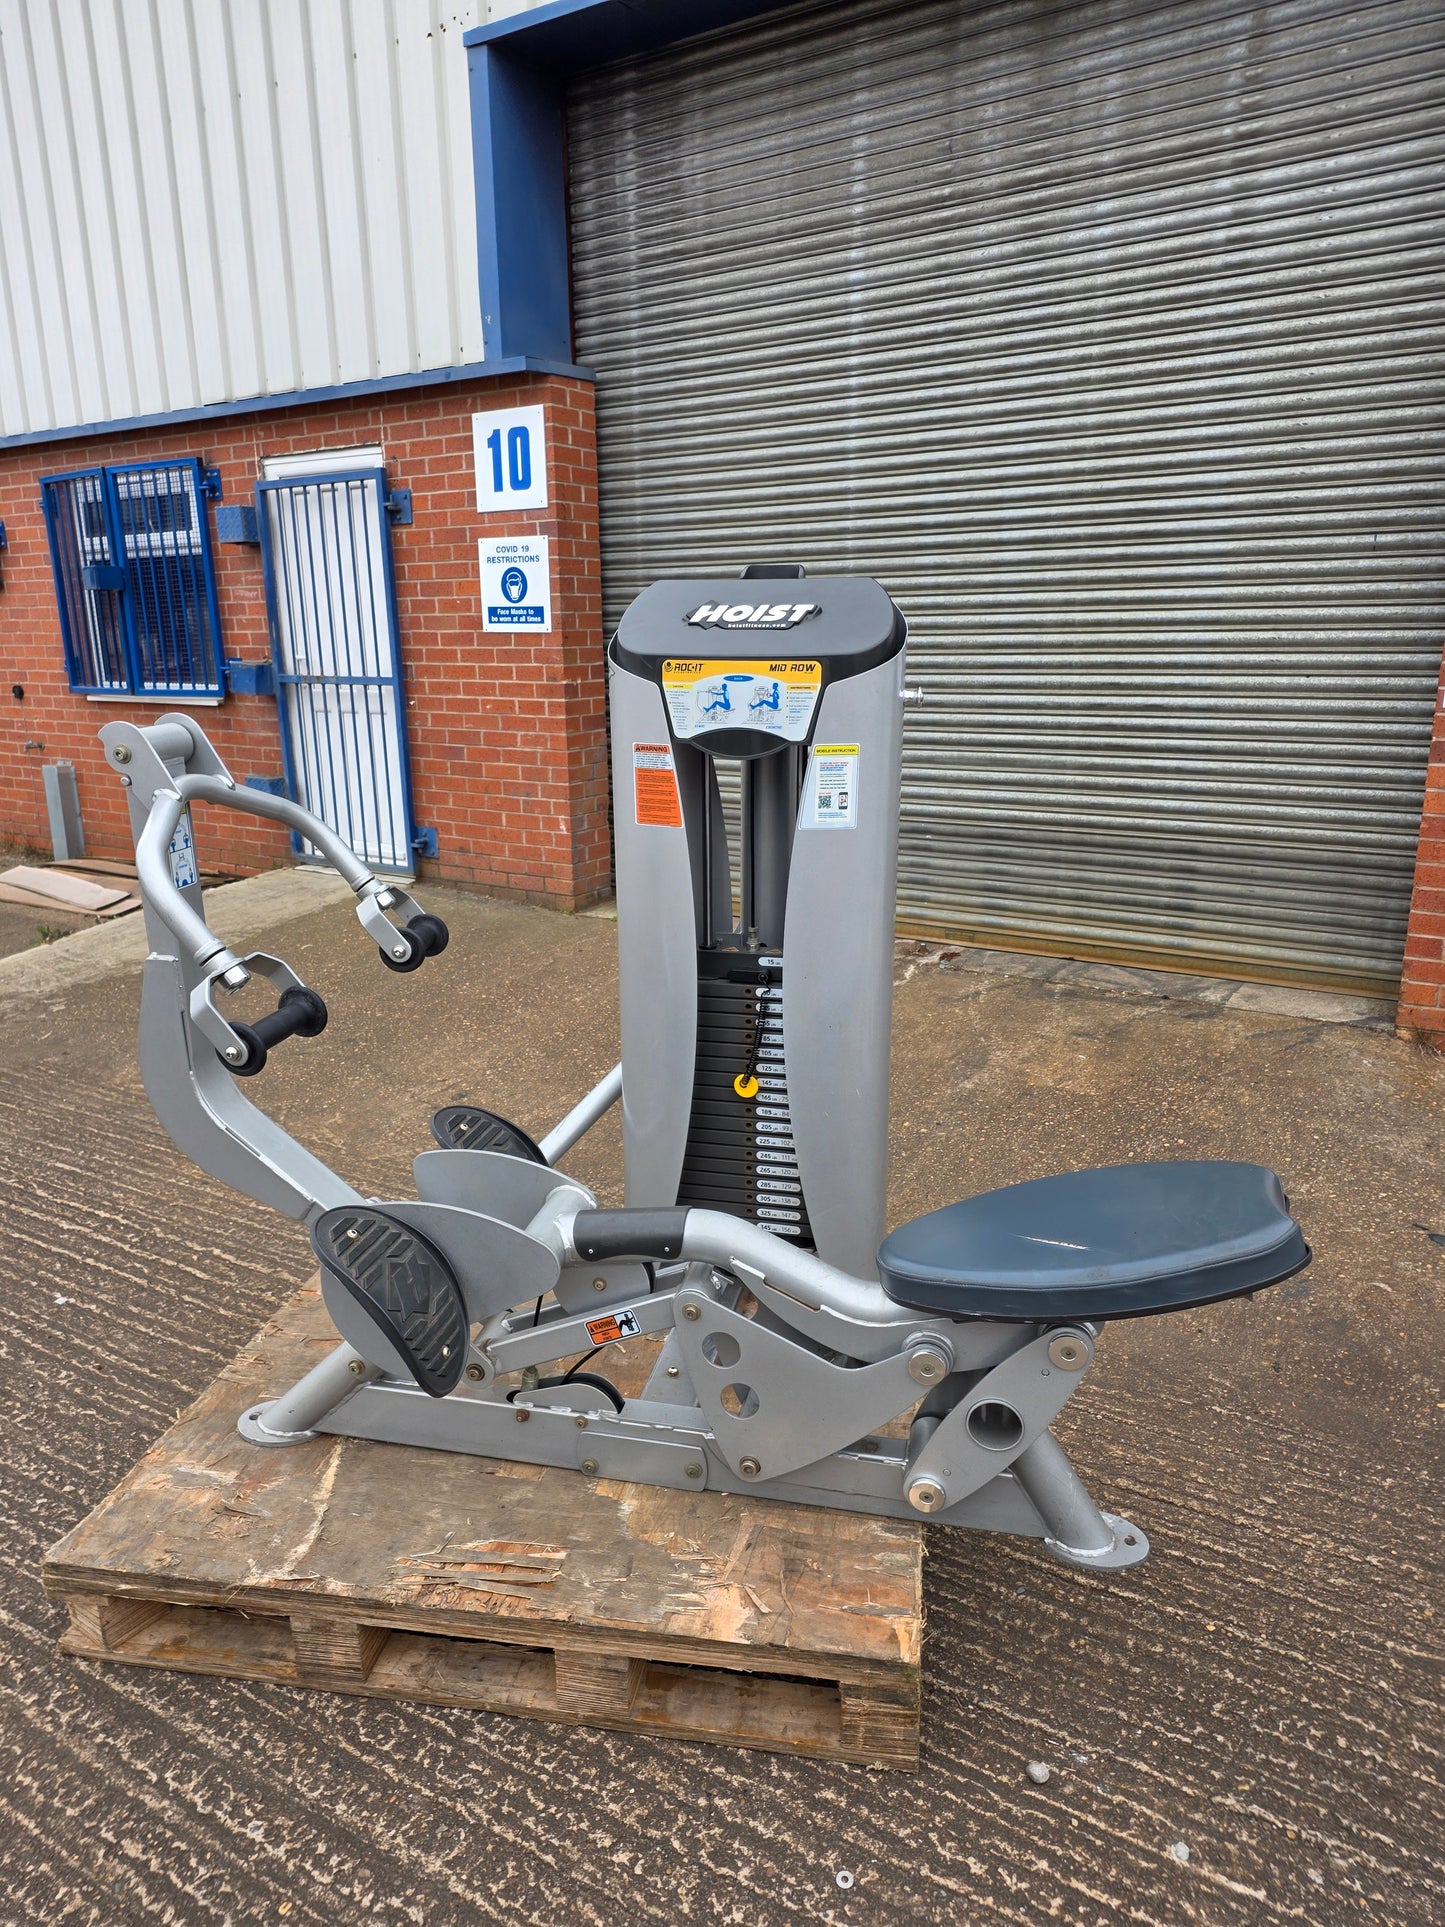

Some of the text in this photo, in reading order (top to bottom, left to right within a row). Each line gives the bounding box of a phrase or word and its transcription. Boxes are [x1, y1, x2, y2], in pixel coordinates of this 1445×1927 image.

[487, 426, 532, 493] 10
[495, 545, 530, 553] COVID 19
[486, 554, 540, 564] RESTRICTIONS
[689, 604, 815, 622] HOIST
[769, 663, 817, 672] MID ROW
[640, 745, 668, 753] WARNING
